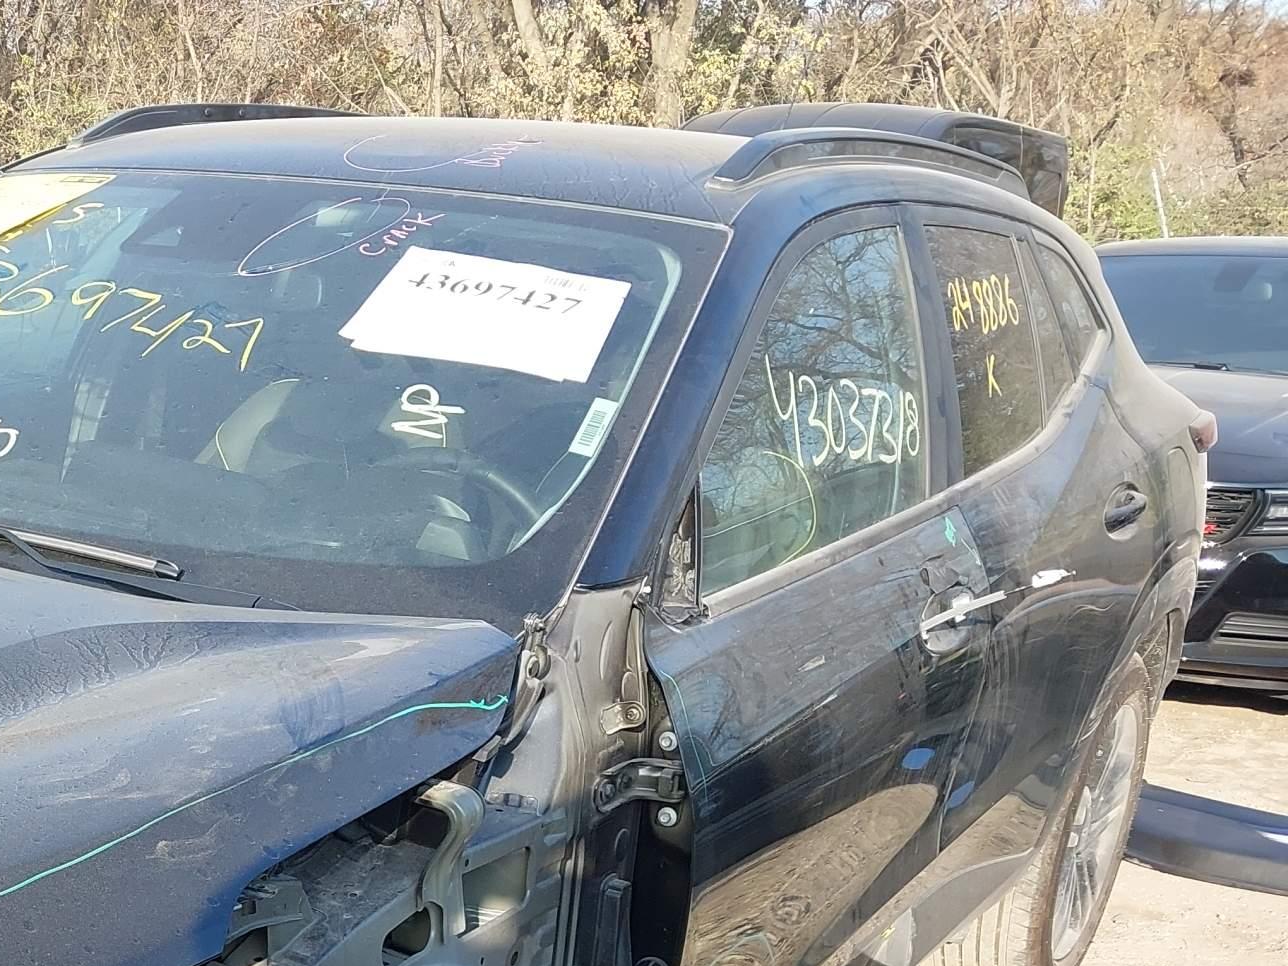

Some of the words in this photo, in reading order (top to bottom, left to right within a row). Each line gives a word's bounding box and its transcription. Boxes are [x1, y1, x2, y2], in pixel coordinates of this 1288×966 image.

[408, 271, 583, 316] 43697427
[948, 273, 1020, 335] 248886
[986, 353, 1003, 398] K
[390, 383, 466, 448] NP
[765, 353, 920, 468] 43037318
